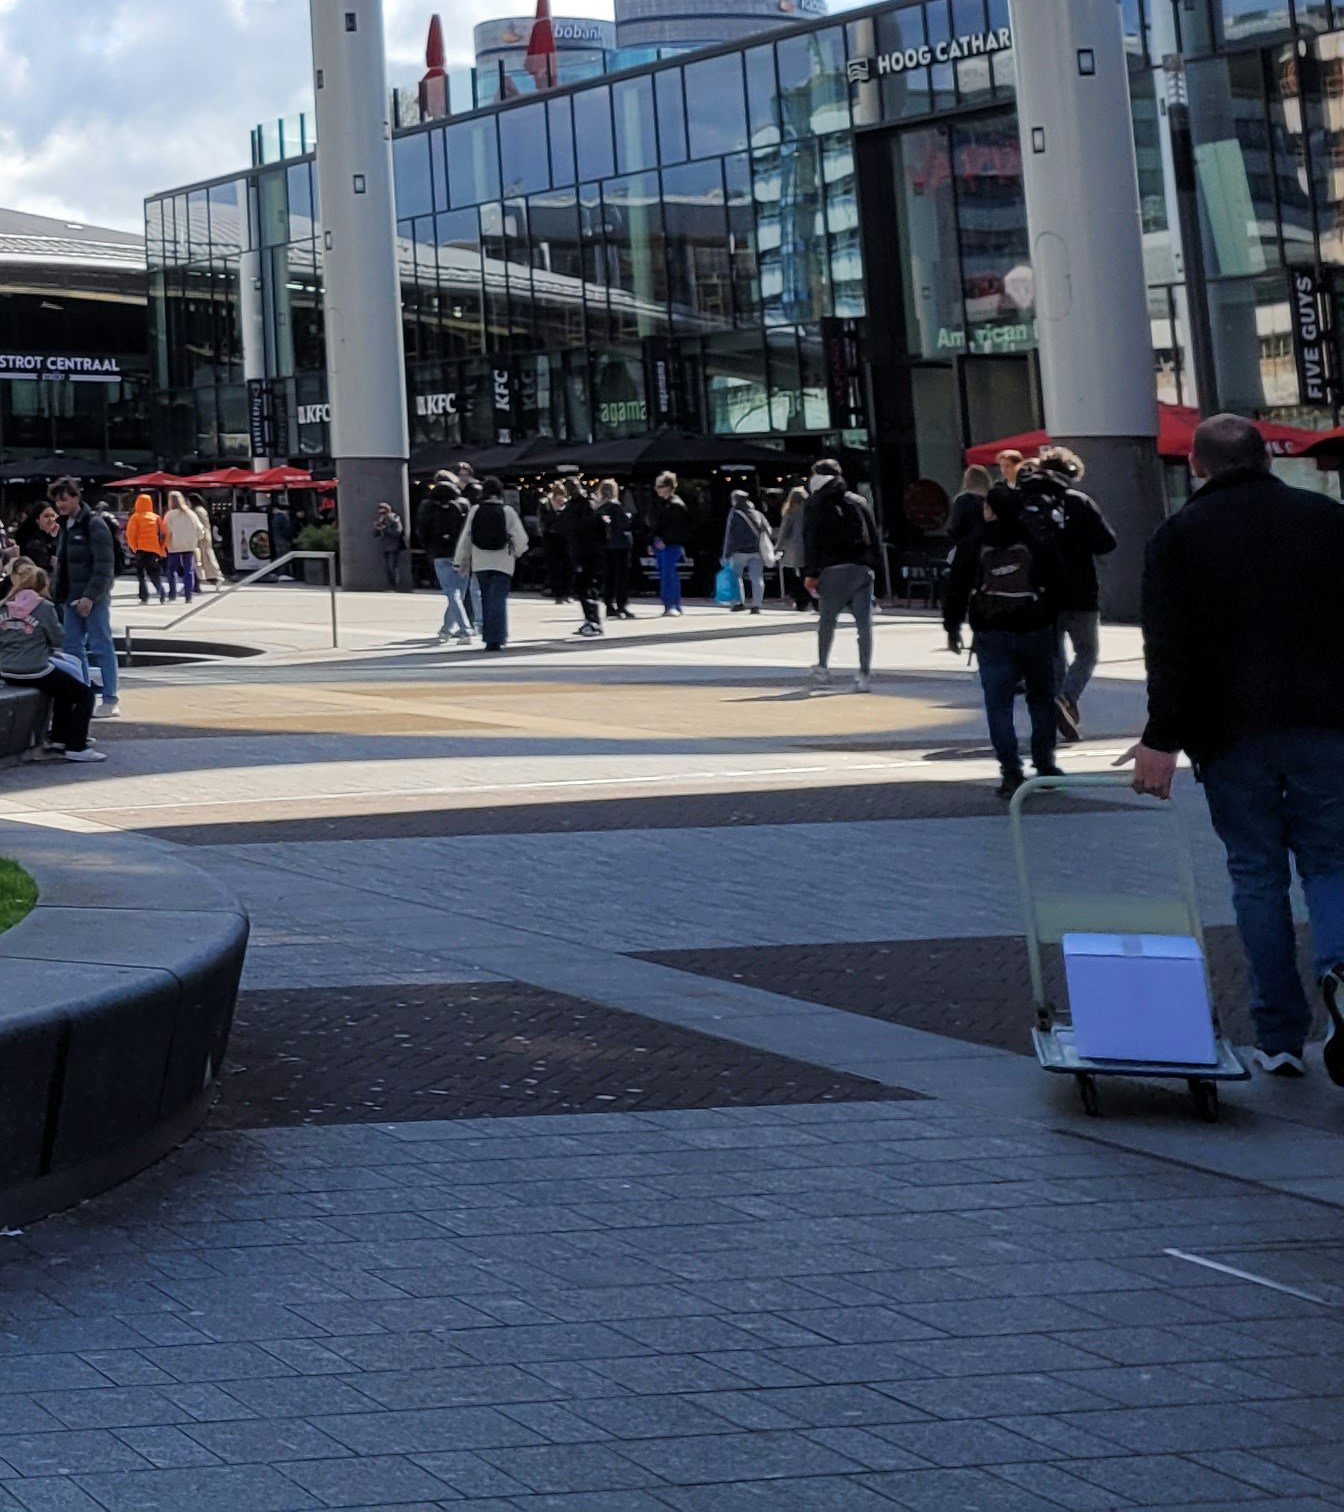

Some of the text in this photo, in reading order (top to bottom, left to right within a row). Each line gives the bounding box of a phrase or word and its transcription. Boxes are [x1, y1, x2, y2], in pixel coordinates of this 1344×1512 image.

[878, 46, 931, 75] HOOG
[938, 324, 1027, 349] Amrican
[1296, 275, 1323, 399] FIVE GUYS
[47, 356, 120, 371] CENTRAAL
[426, 393, 457, 415] KFC
[493, 369, 511, 412] KFC
